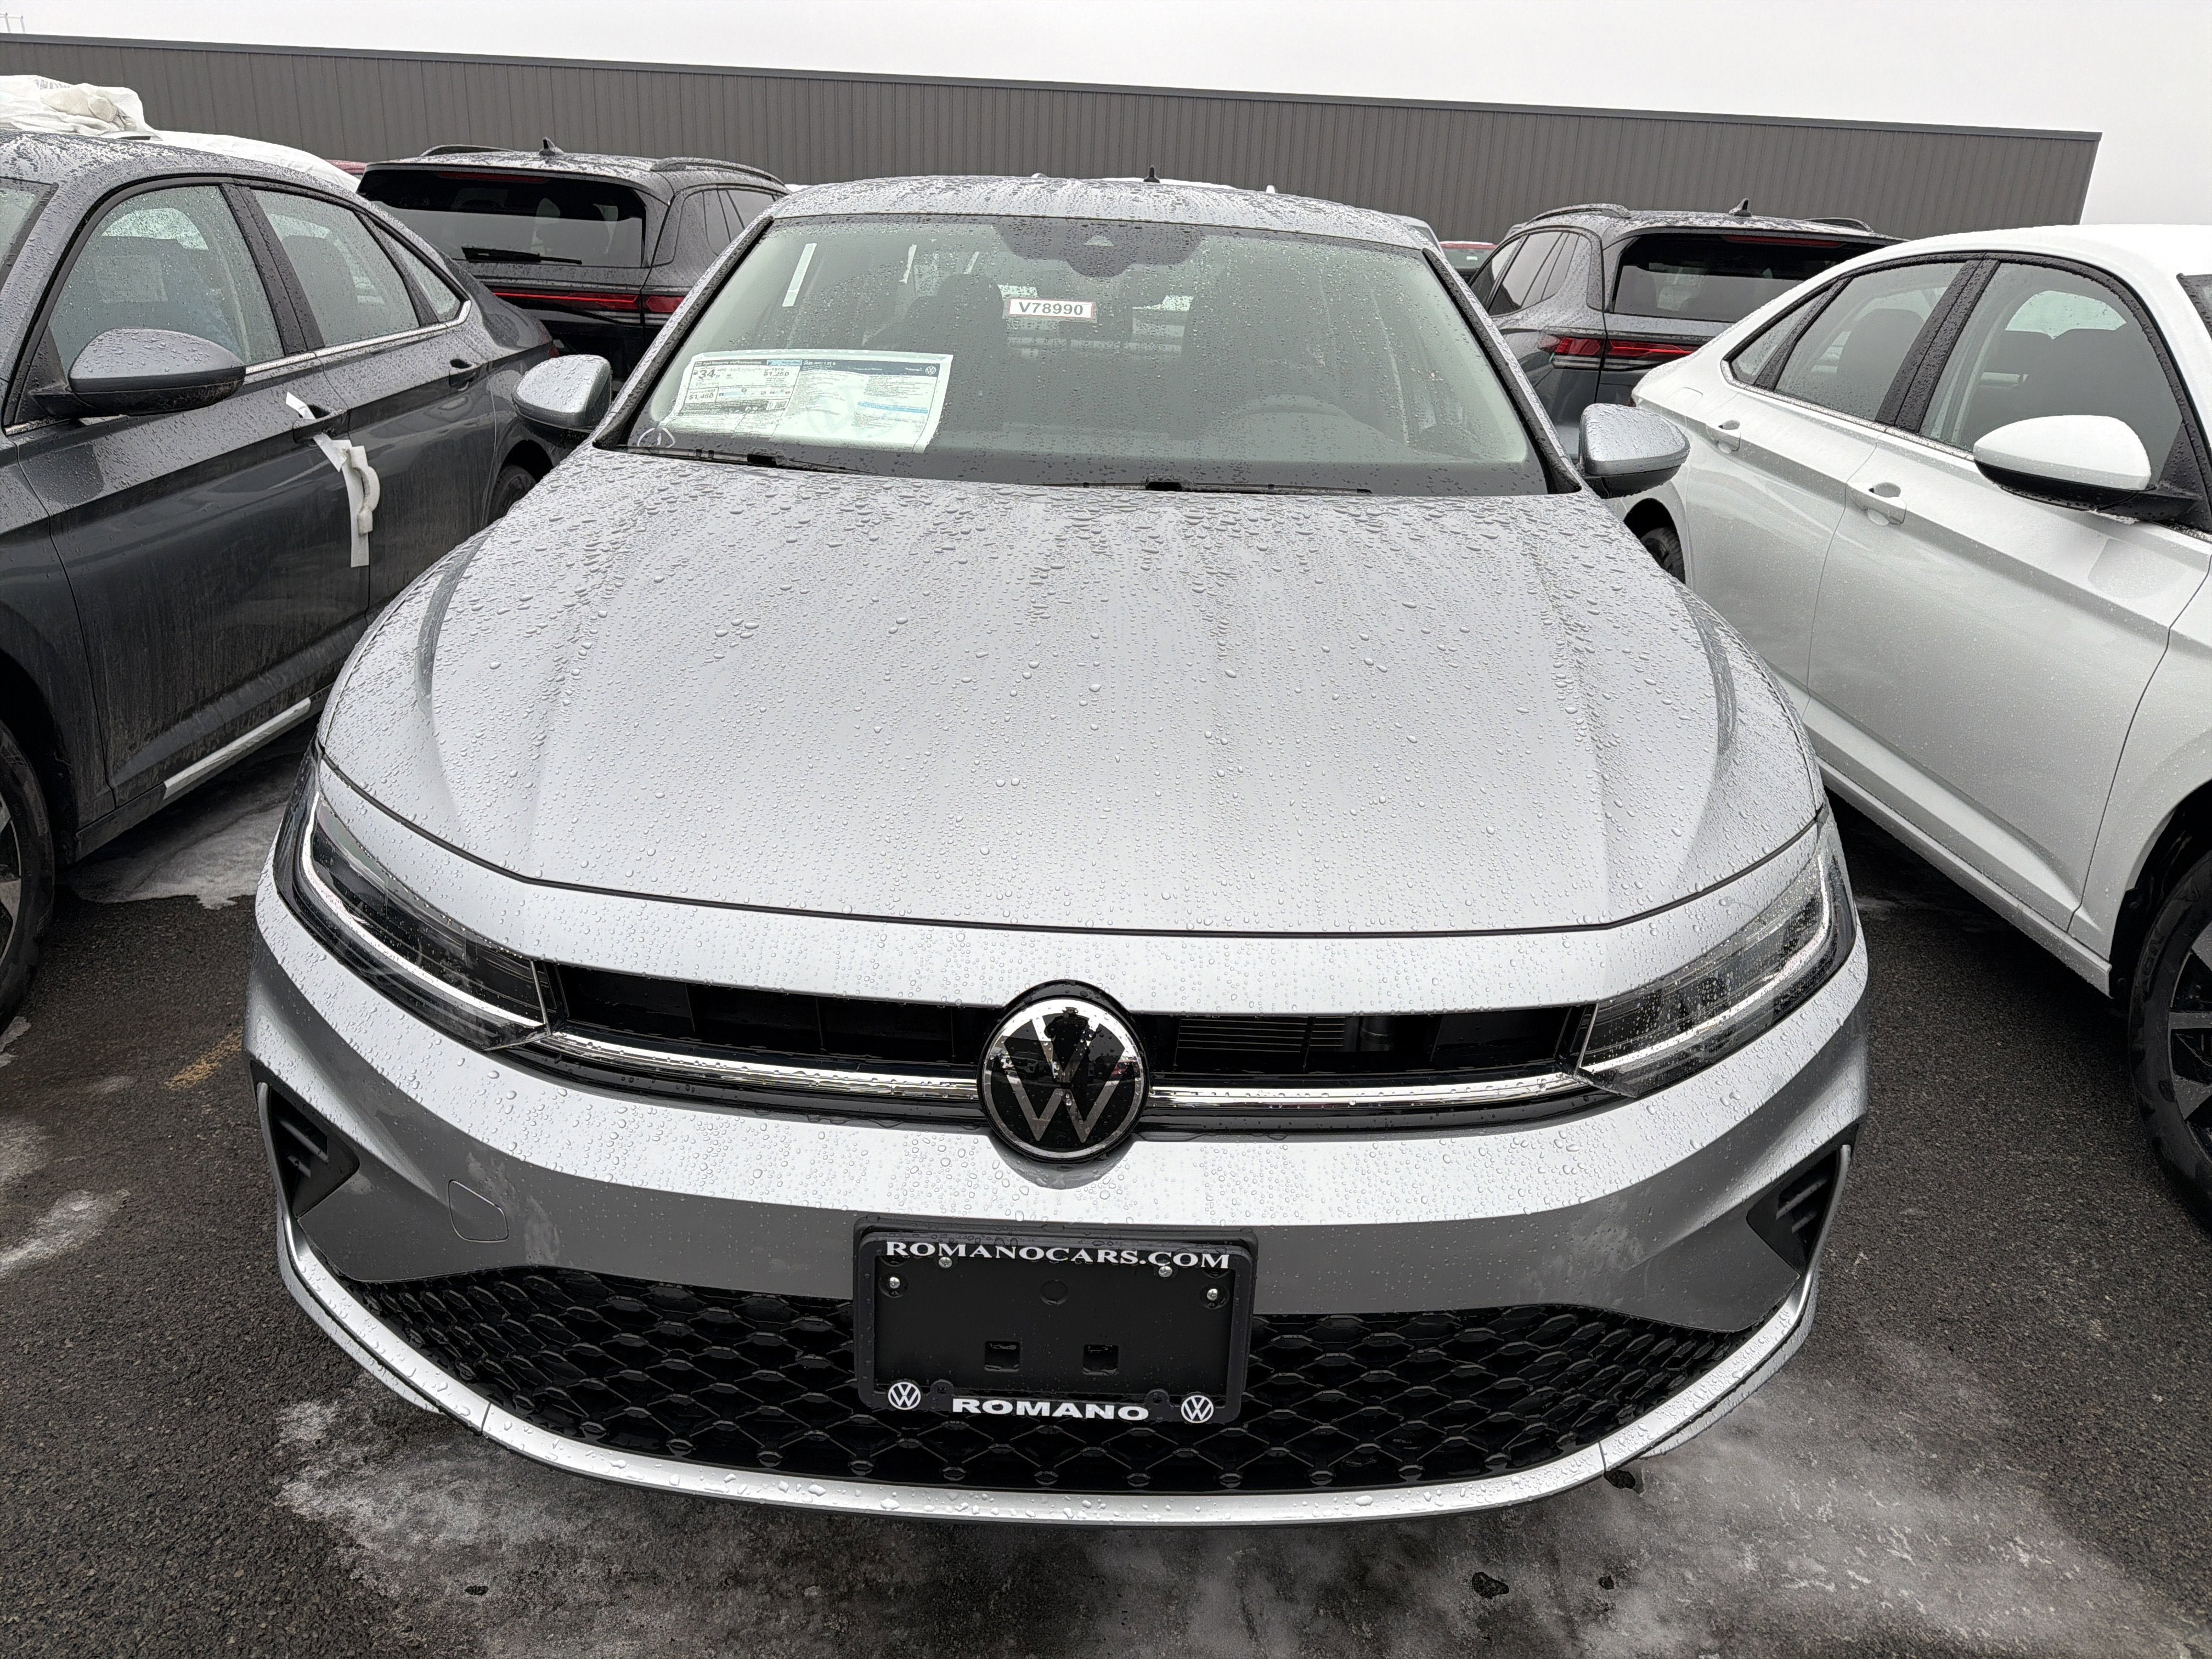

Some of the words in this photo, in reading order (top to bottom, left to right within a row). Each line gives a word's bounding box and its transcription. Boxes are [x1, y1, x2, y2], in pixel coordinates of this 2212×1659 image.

[1018, 302, 1084, 315] V78990
[887, 1242, 1229, 1269] ROMANOCARS.COM
[952, 1398, 1149, 1421] ROMANO
